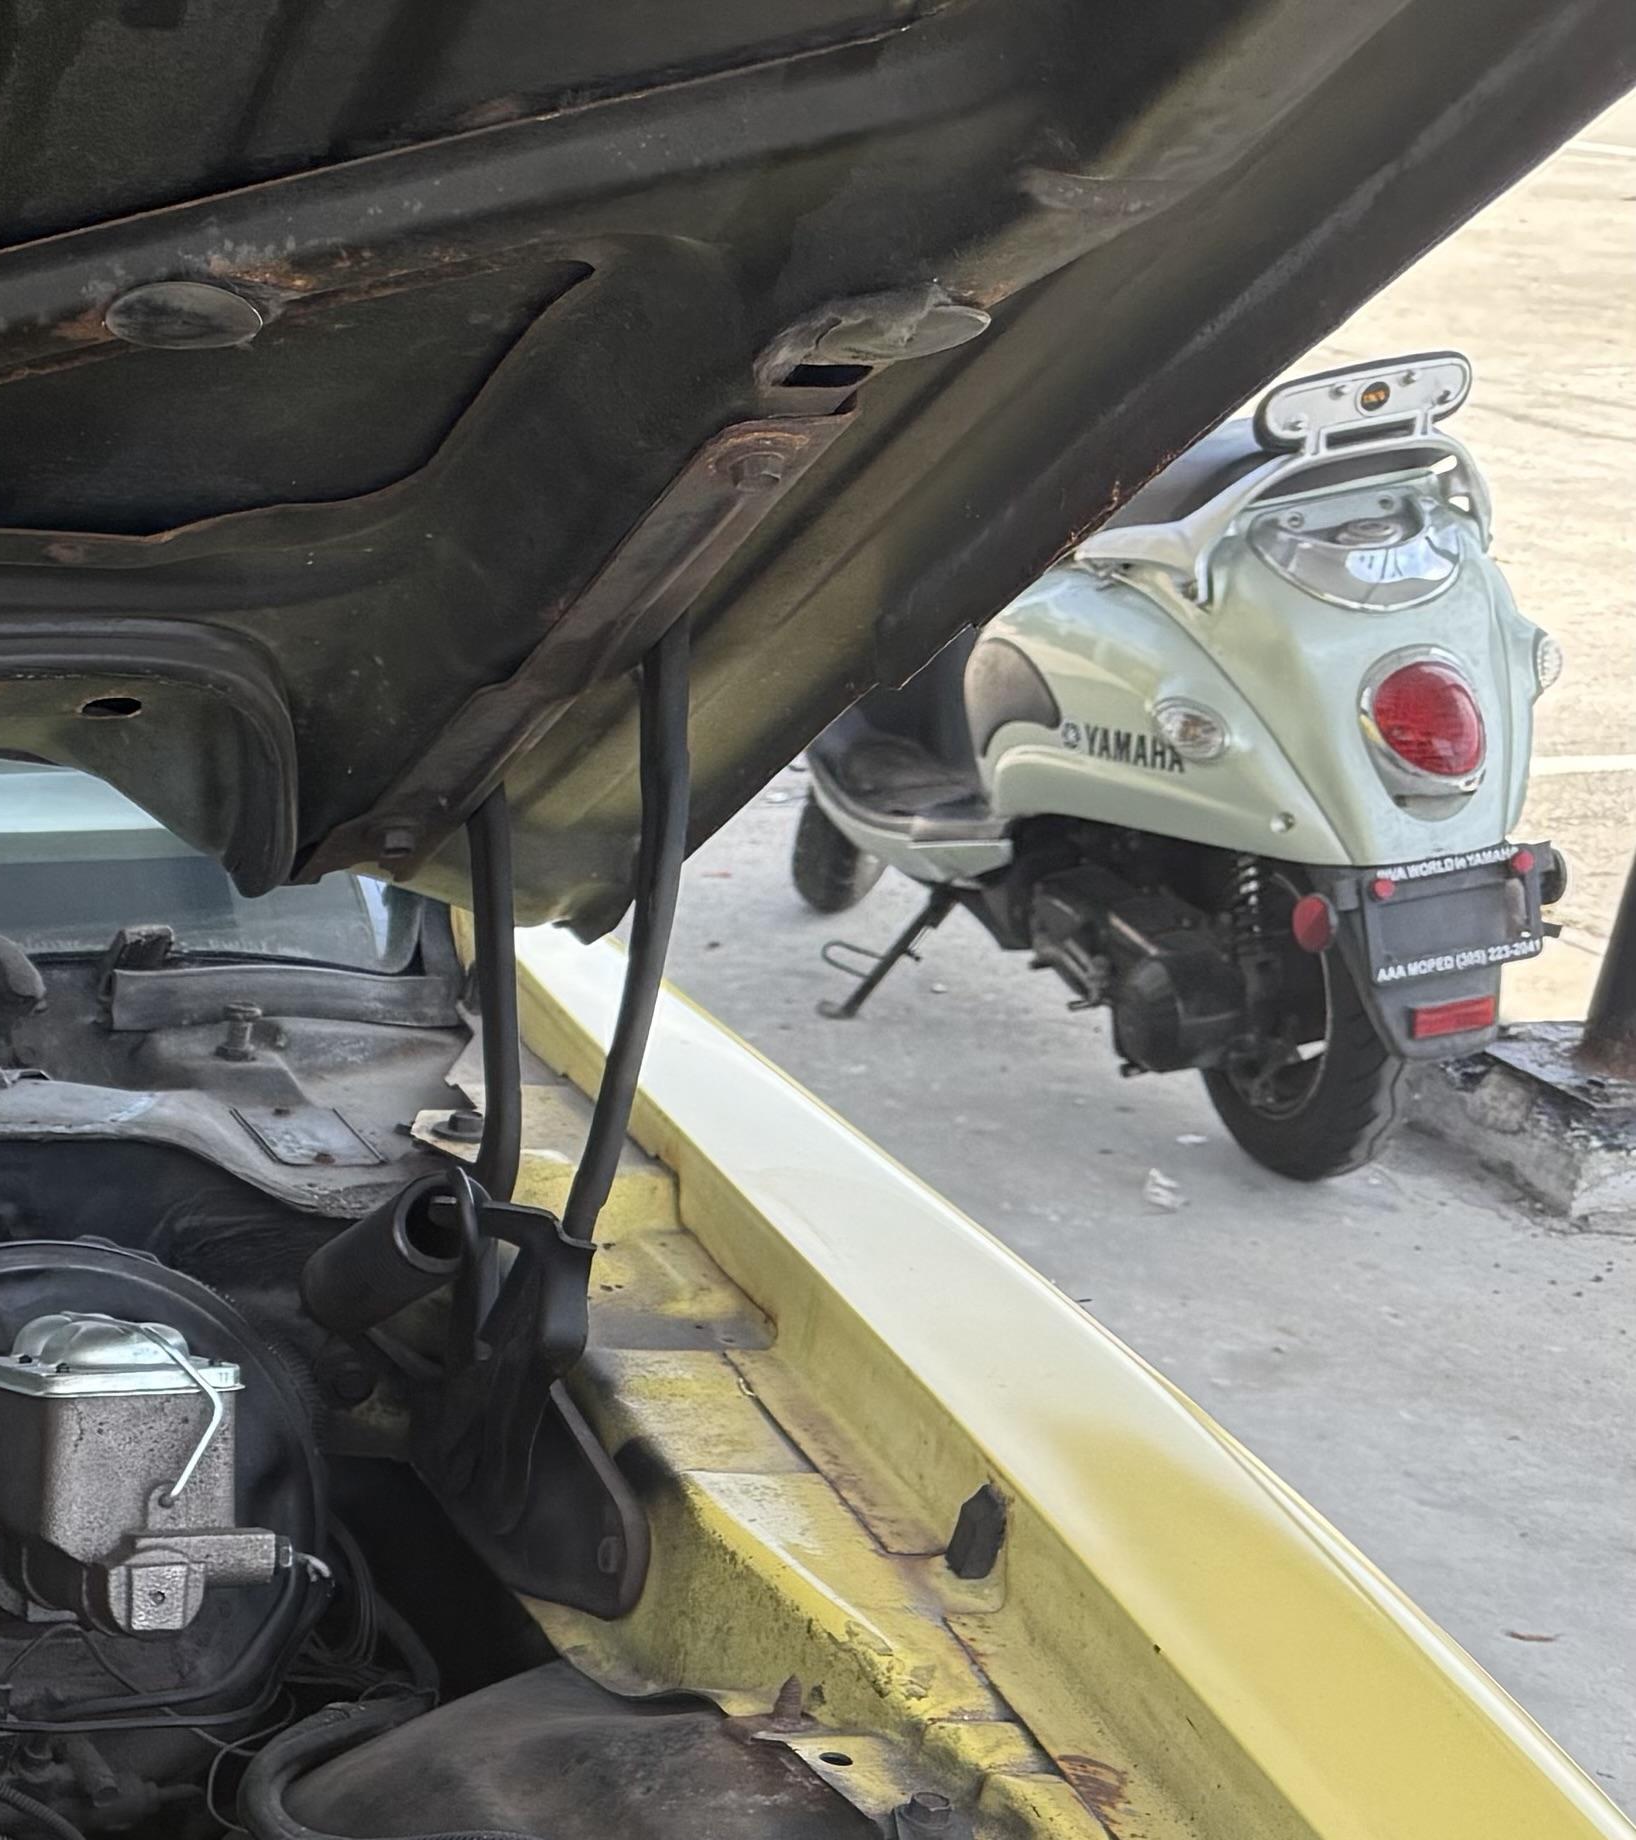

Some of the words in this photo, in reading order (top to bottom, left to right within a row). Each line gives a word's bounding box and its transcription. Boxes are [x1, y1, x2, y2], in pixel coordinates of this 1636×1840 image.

[1085, 724, 1186, 773] YAMAHA
[1407, 857, 1454, 879] WORLD
[1377, 965, 1407, 983] AAA
[1407, 955, 1455, 977] MOPED
